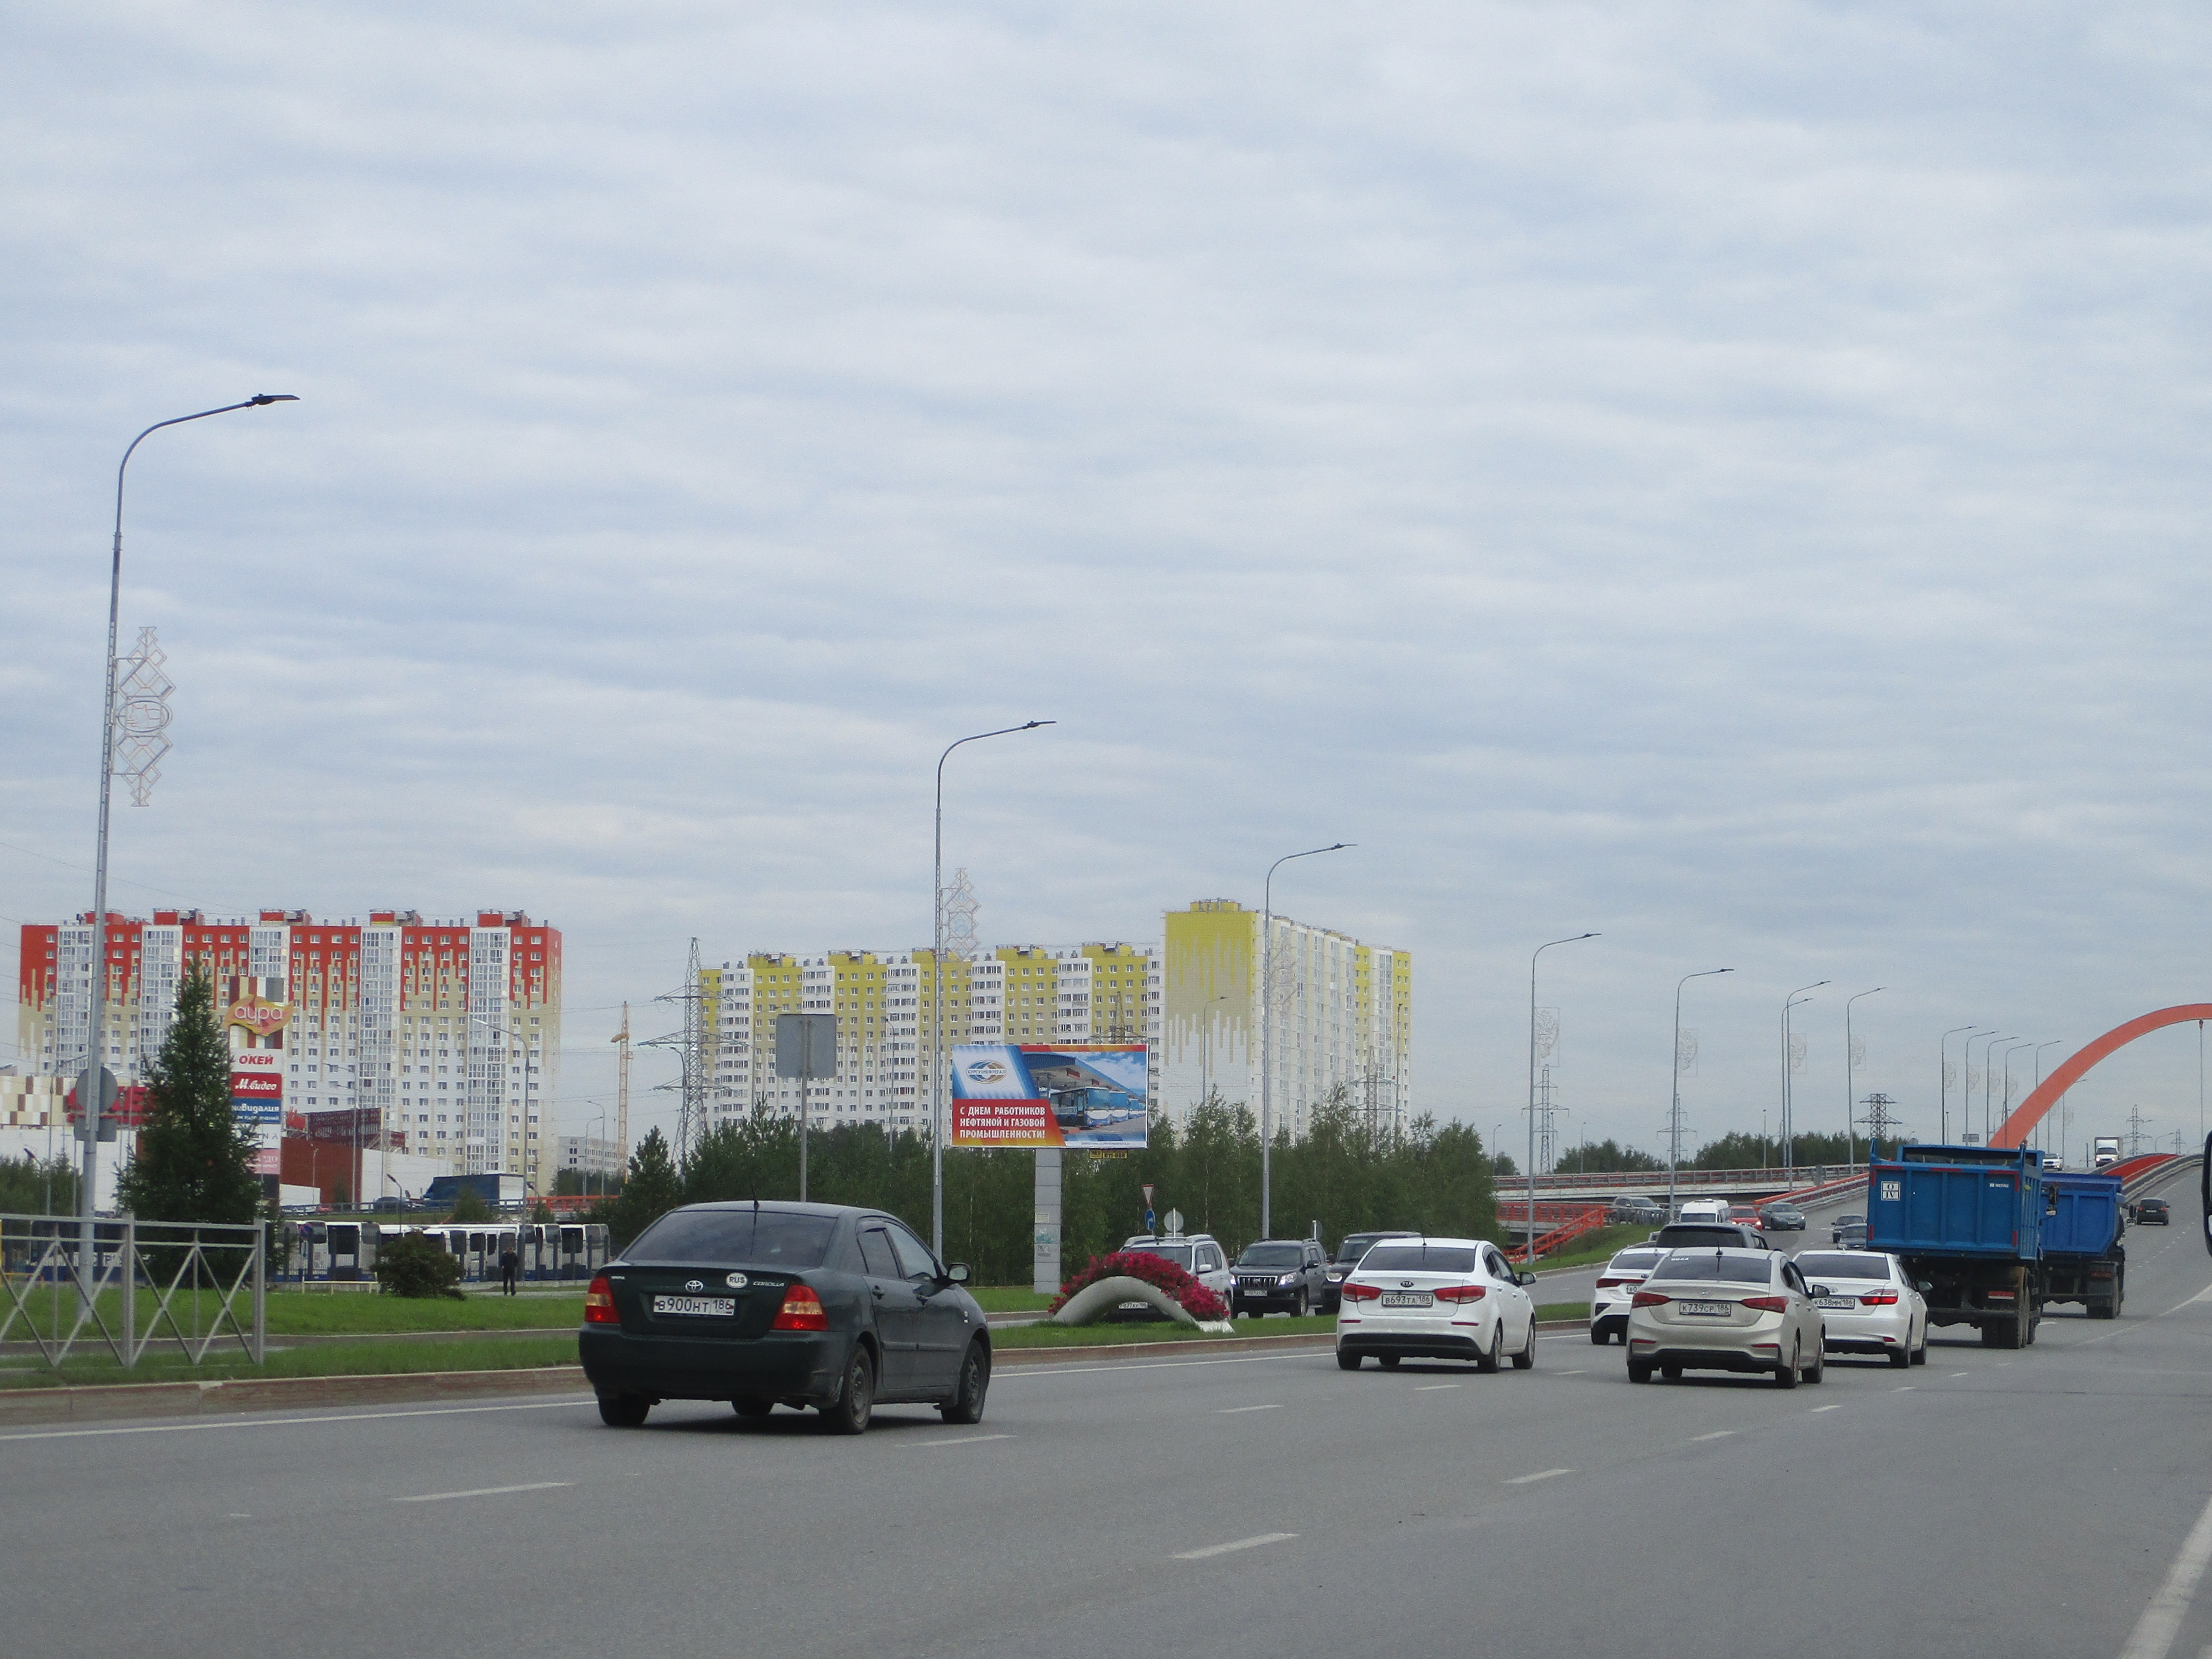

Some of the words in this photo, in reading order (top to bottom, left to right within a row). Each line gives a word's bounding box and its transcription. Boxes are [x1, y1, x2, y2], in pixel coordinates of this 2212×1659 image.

[235, 1006, 282, 1025] аура
[239, 1054, 274, 1064] О'КЕЙ
[960, 1106, 965, 1115] С
[968, 1106, 991, 1116] ДНЕМ
[995, 1106, 1045, 1115] РАБОТНИКОВ
[960, 1117, 1002, 1127] НЕФТЯНОЙ
[1011, 1117, 1045, 1127] ГАЗОВОЙ
[960, 1130, 1045, 1138] ПРОМЫШЛЕННОСТИ!
[658, 1298, 709, 1312] В900НТ
[713, 1299, 733, 1310] 186
[1682, 1304, 1714, 1312] К739СР
